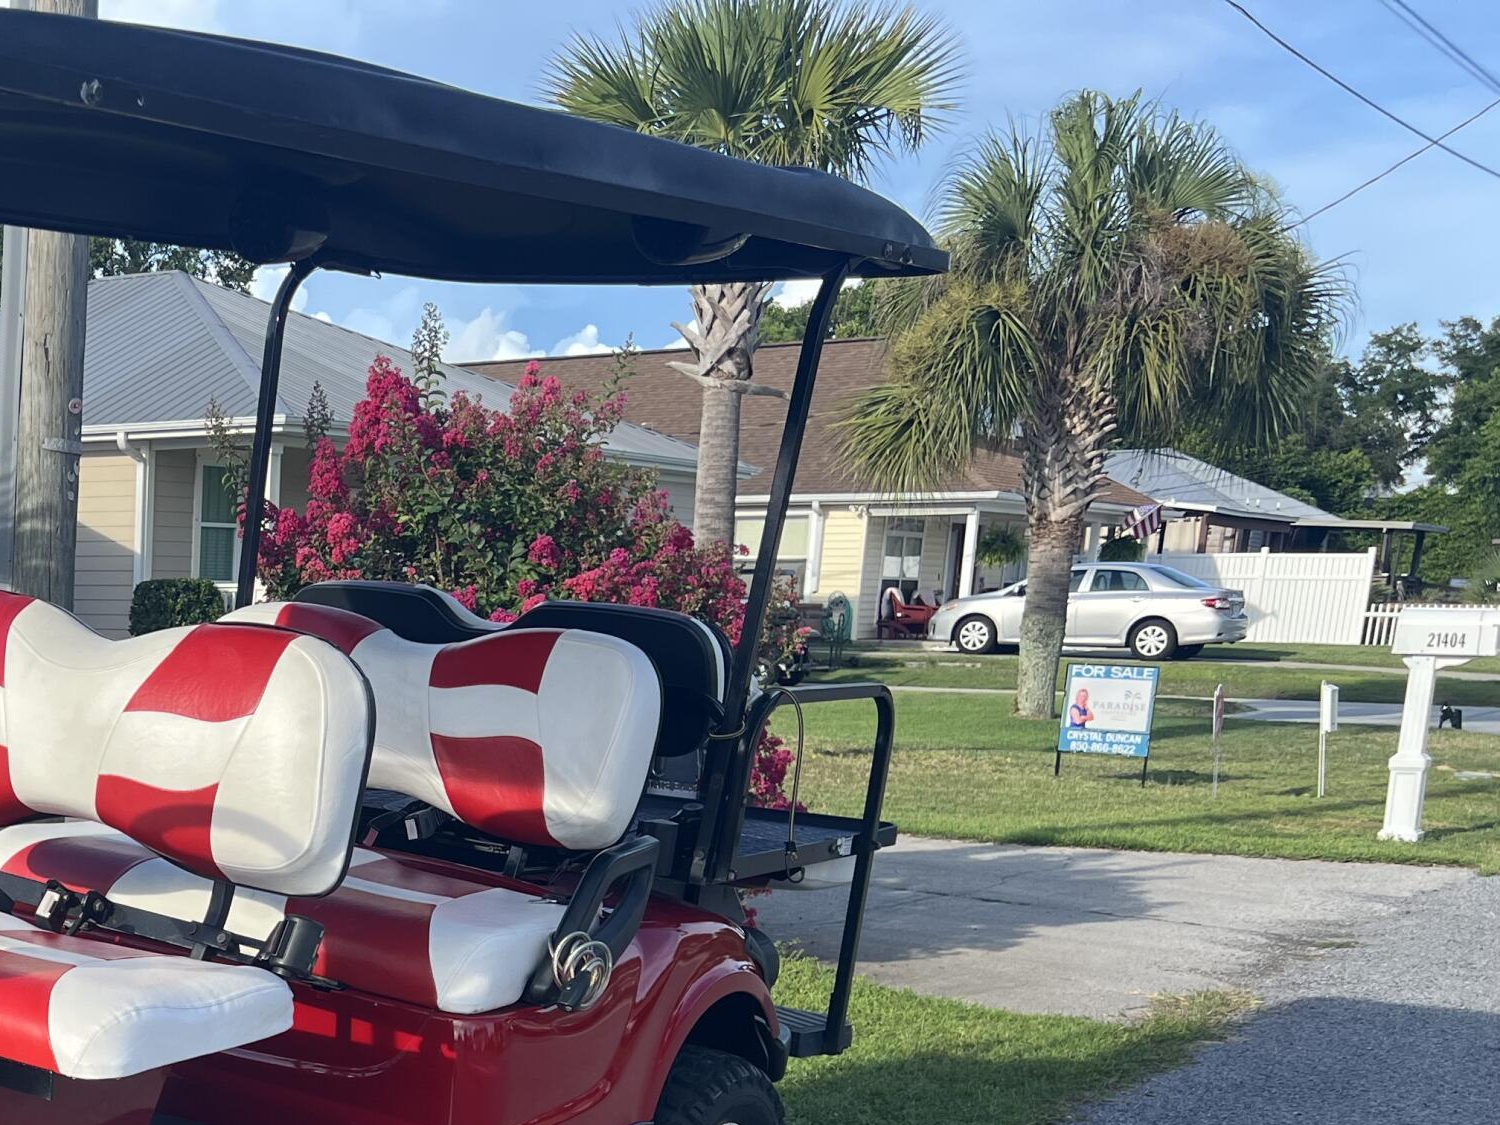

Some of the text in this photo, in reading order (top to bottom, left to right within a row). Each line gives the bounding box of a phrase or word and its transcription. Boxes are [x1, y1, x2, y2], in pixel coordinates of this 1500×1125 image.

[1426, 632, 1466, 648] 21404
[1071, 665, 1155, 679] FOR SALE
[1092, 701, 1147, 712] PARADISE
[1067, 730, 1142, 744] CRYSTAL DUNCAN
